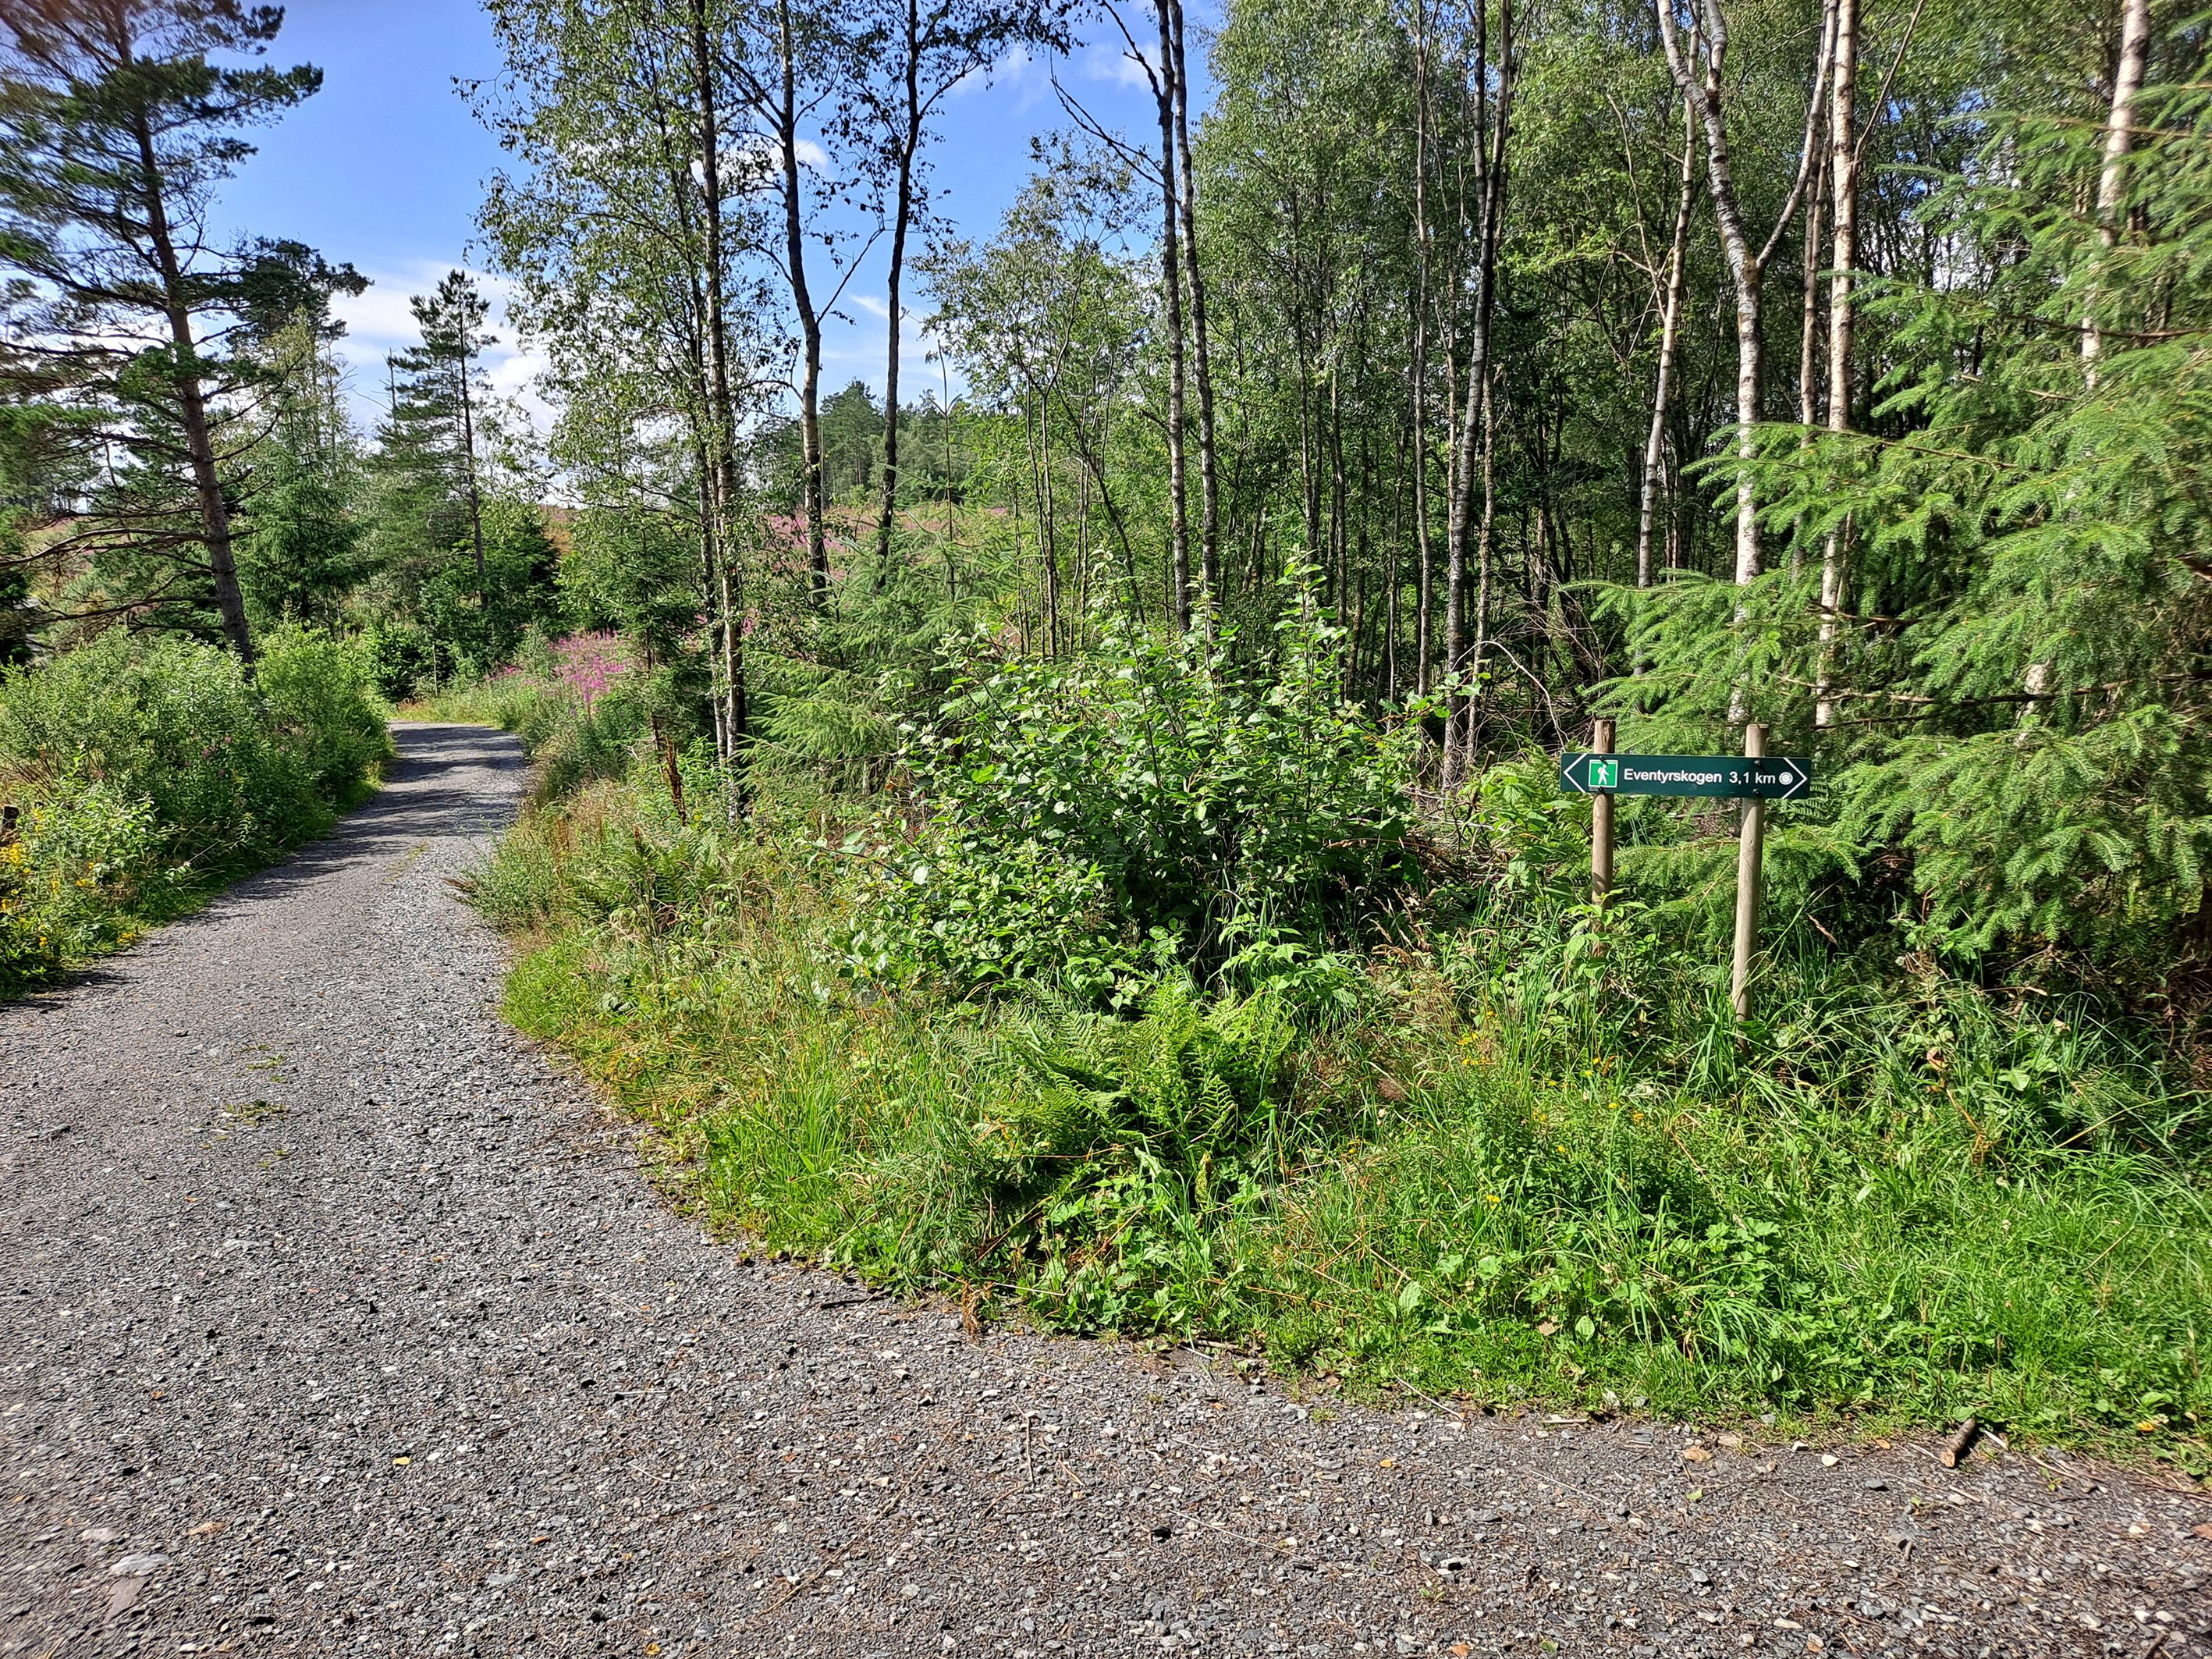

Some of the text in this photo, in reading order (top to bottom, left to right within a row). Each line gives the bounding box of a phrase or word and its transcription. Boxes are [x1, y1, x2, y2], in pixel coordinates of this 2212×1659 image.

[1624, 768, 1722, 785] Eventyrskogen
[1729, 771, 1749, 784] 3,1
[1755, 772, 1776, 784] km
